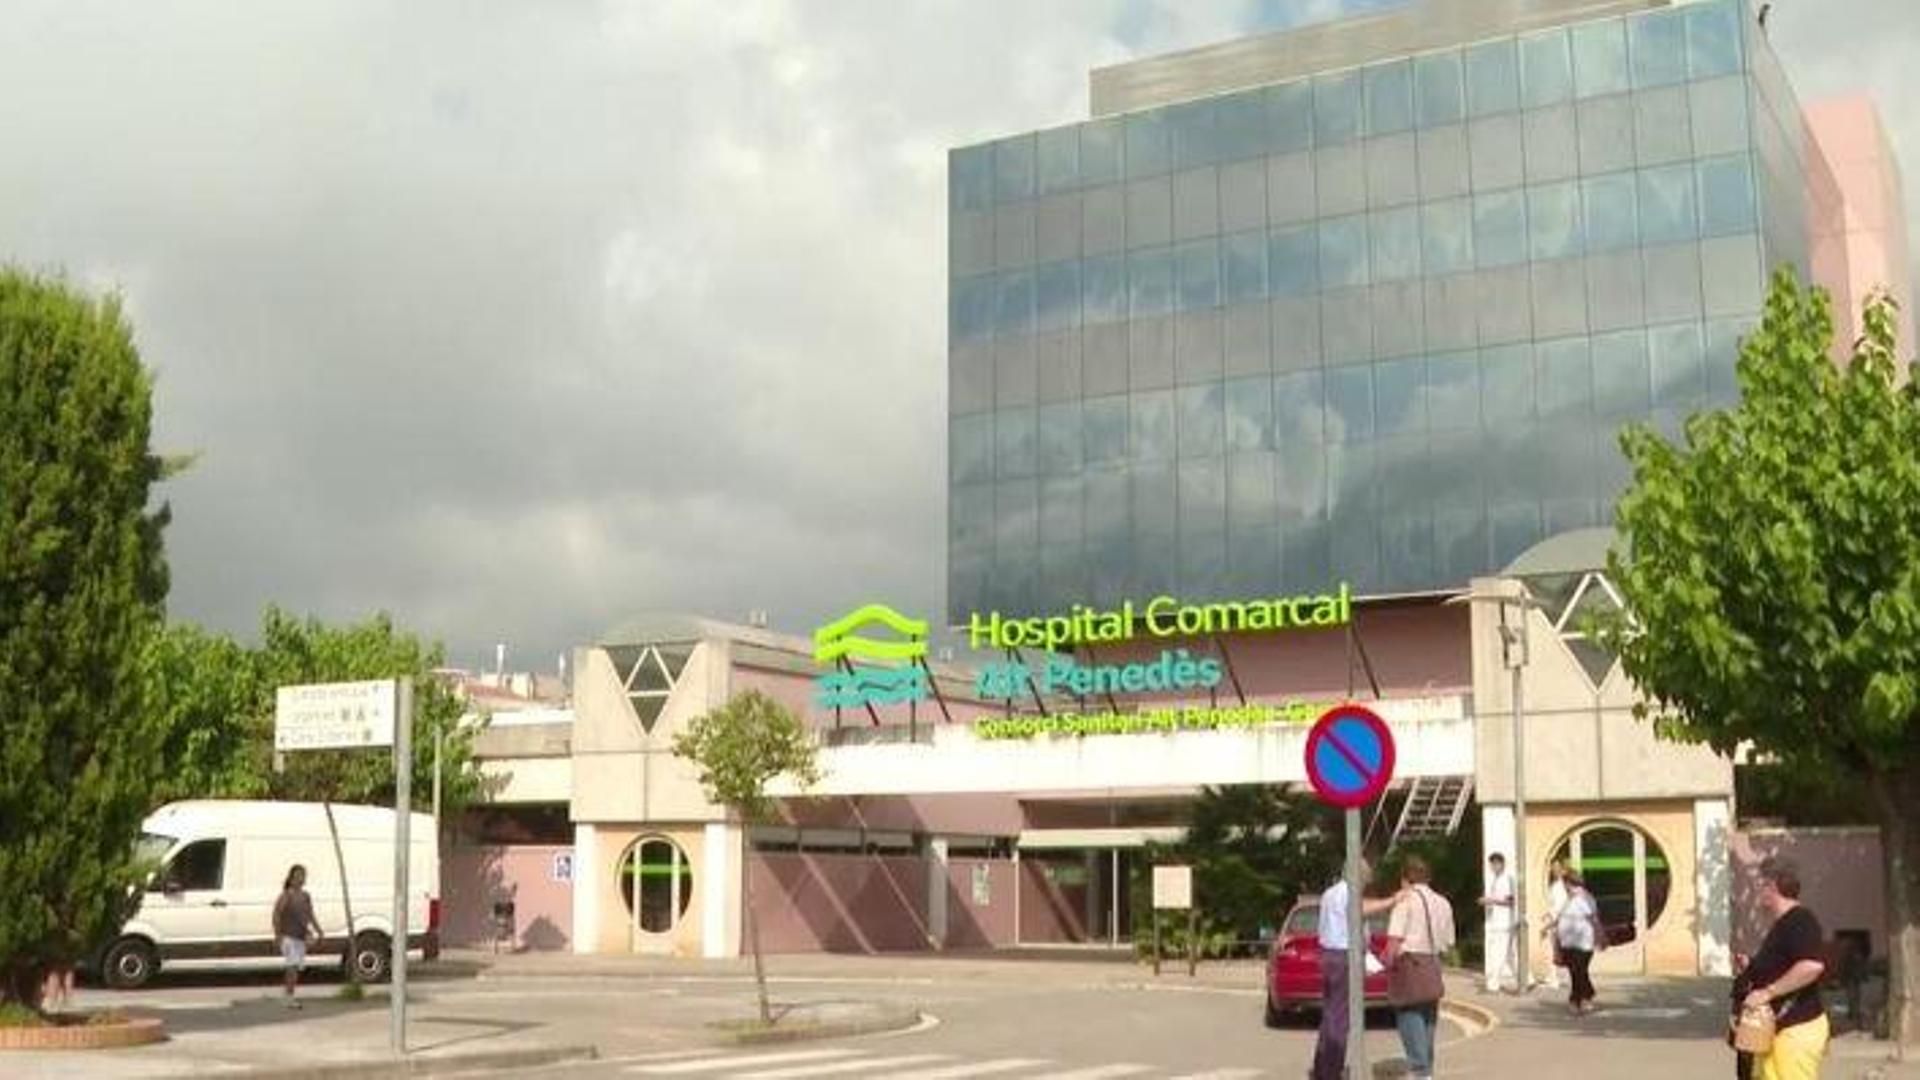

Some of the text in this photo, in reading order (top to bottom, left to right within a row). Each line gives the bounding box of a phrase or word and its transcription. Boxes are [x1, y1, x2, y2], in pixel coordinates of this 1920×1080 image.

[970, 581, 1350, 651] Hospital Comarcal
[1045, 649, 1222, 695] Penedès
